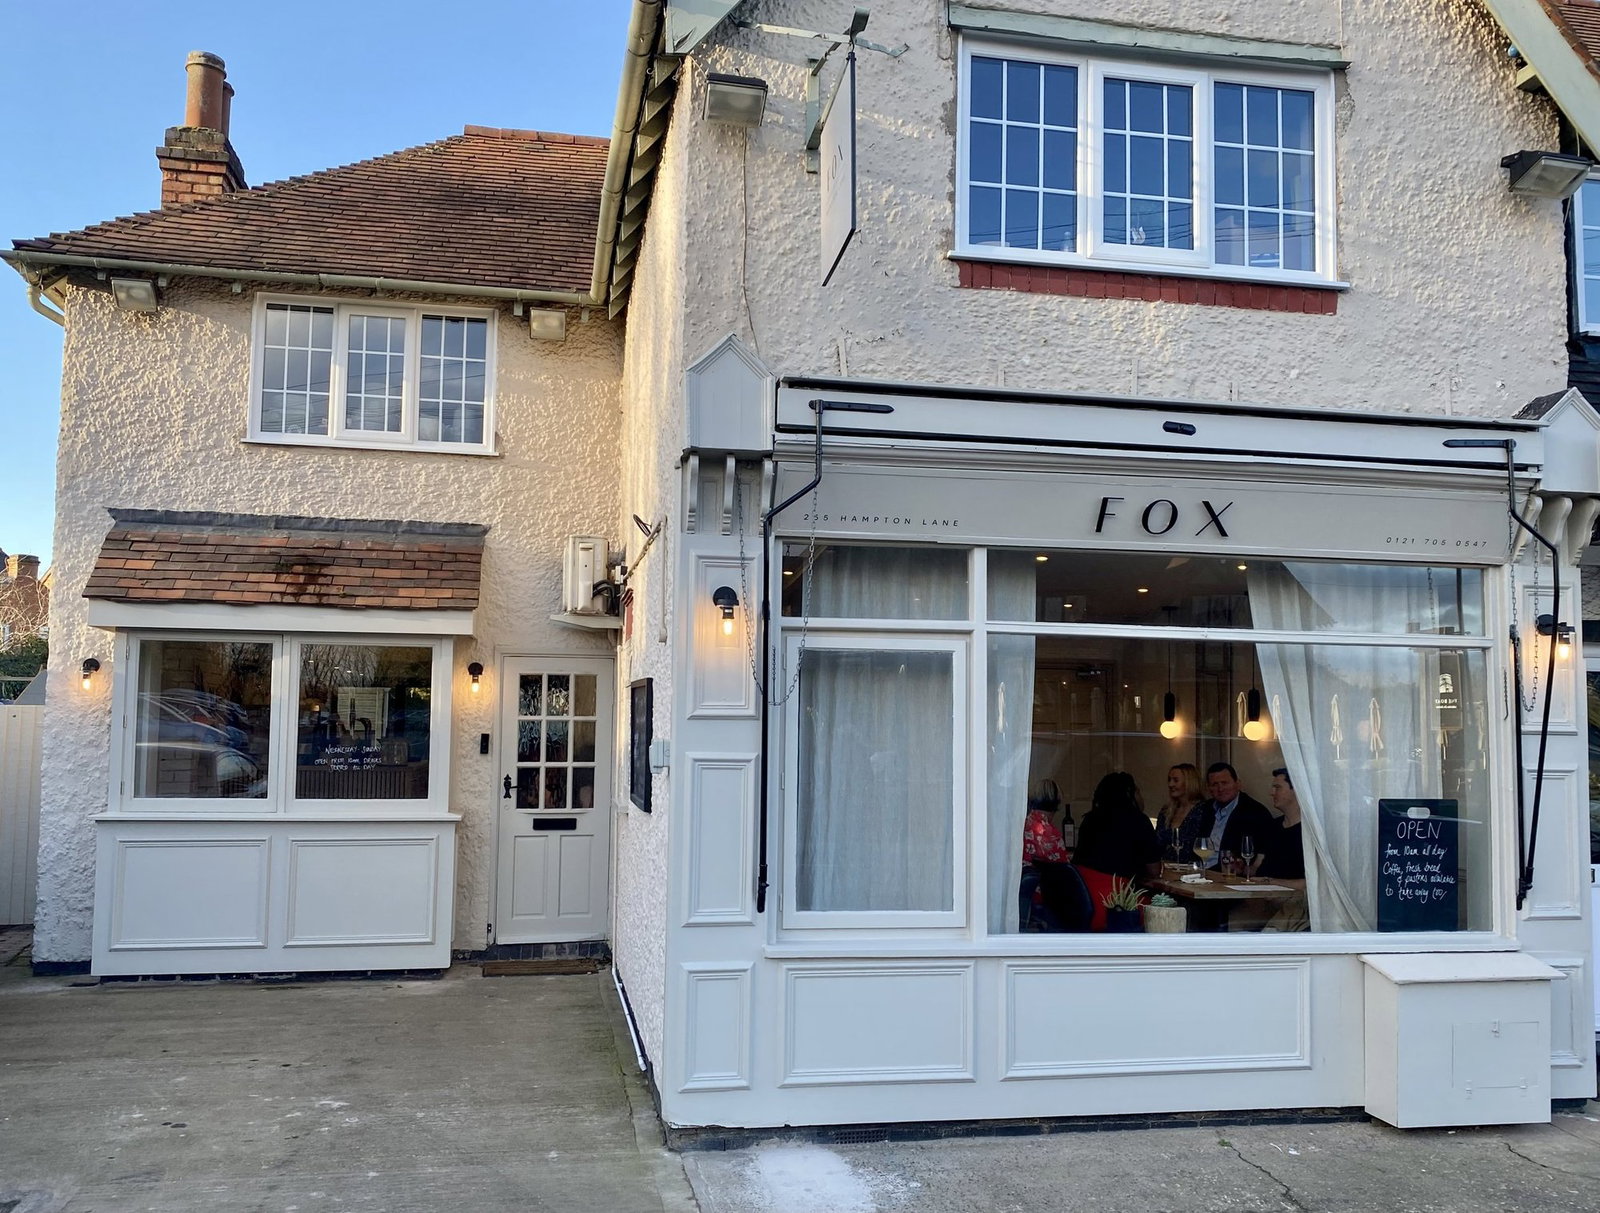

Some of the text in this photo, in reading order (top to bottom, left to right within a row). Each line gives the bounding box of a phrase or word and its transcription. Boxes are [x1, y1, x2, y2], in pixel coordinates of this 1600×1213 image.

[803, 513, 960, 527] 255 HAMPTON LANE
[1095, 496, 1234, 538] FOX
[1386, 536, 1487, 548] 0121 705 0547
[1396, 820, 1442, 840] OPEN
[1431, 843, 1448, 860] day
[1385, 883, 1394, 897] to
